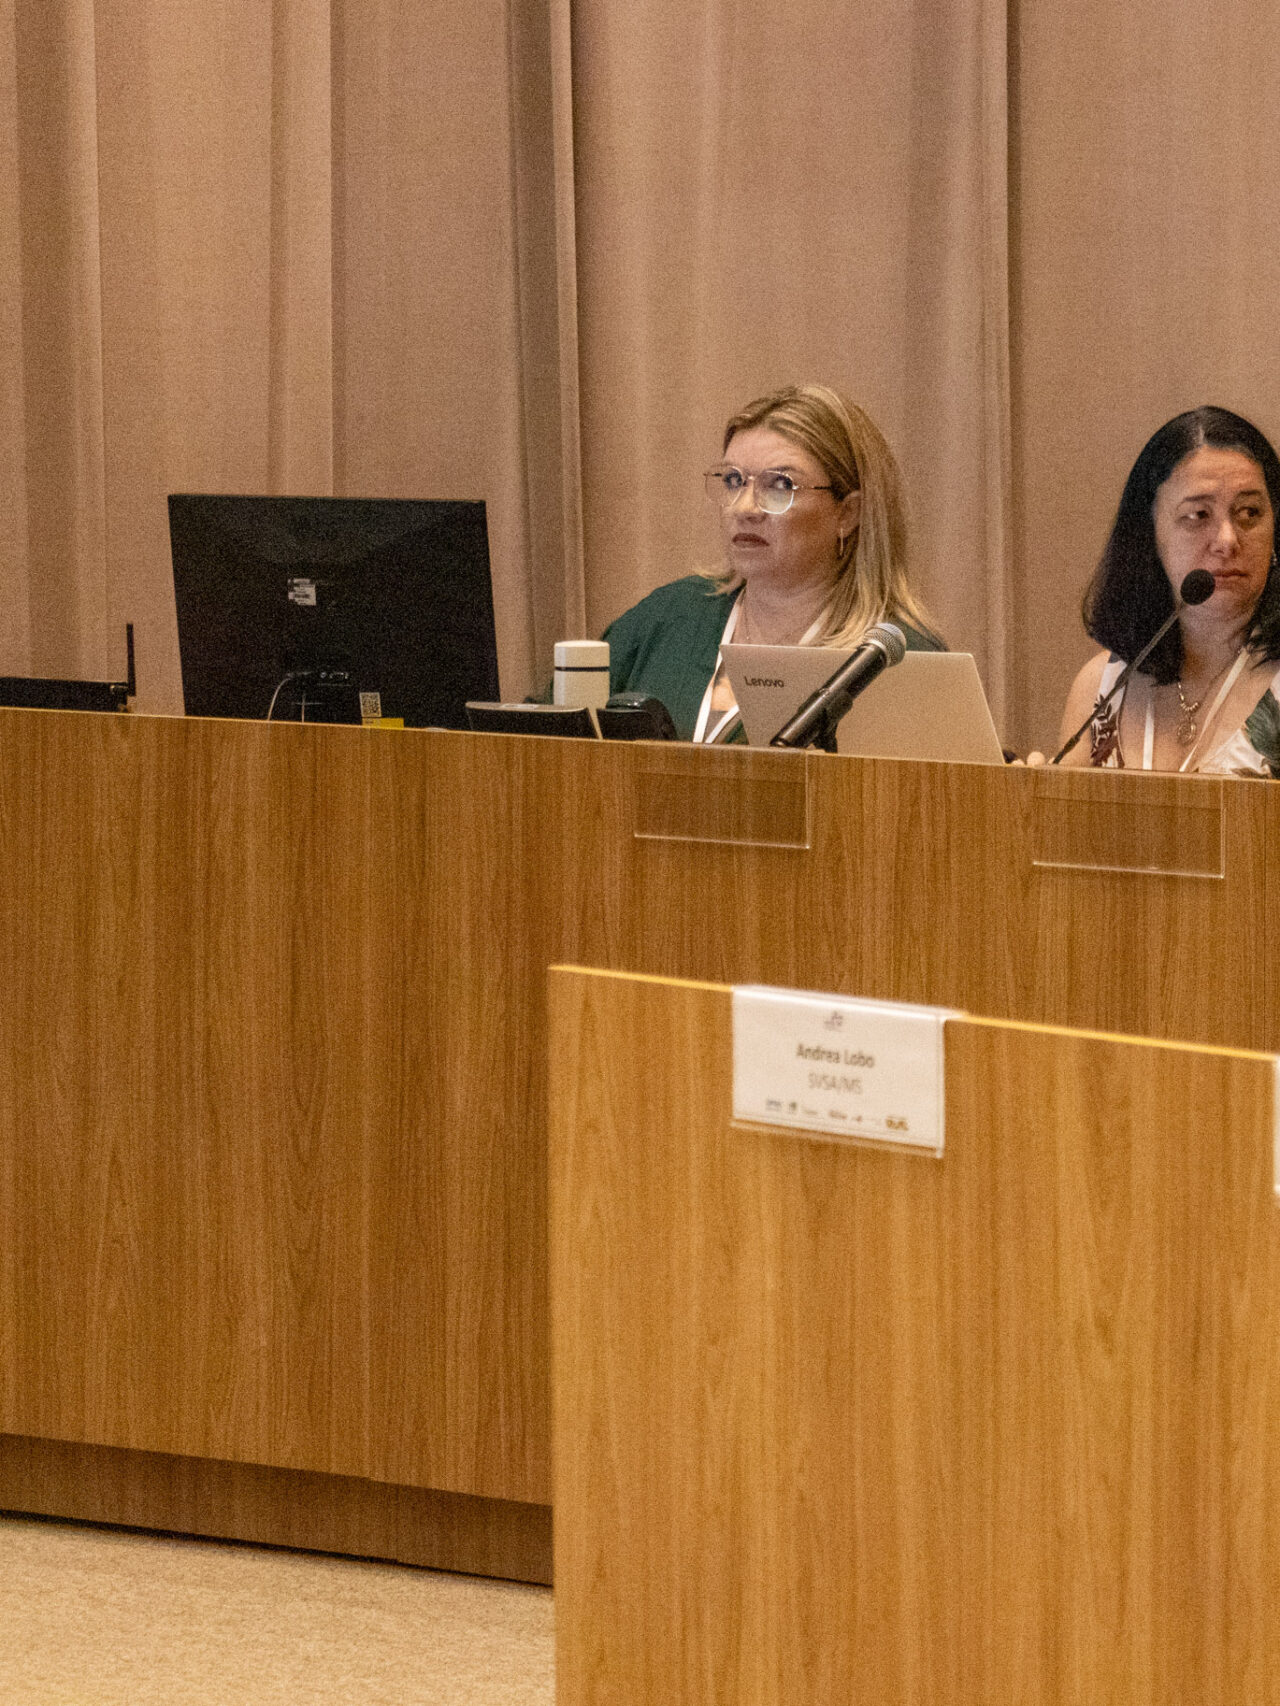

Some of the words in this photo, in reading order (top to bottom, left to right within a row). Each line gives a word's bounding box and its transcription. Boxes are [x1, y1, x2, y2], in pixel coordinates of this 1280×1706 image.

[744, 676, 785, 688] Lenovo
[796, 1043, 841, 1065] Andrea
[844, 1048, 876, 1069] Lobo
